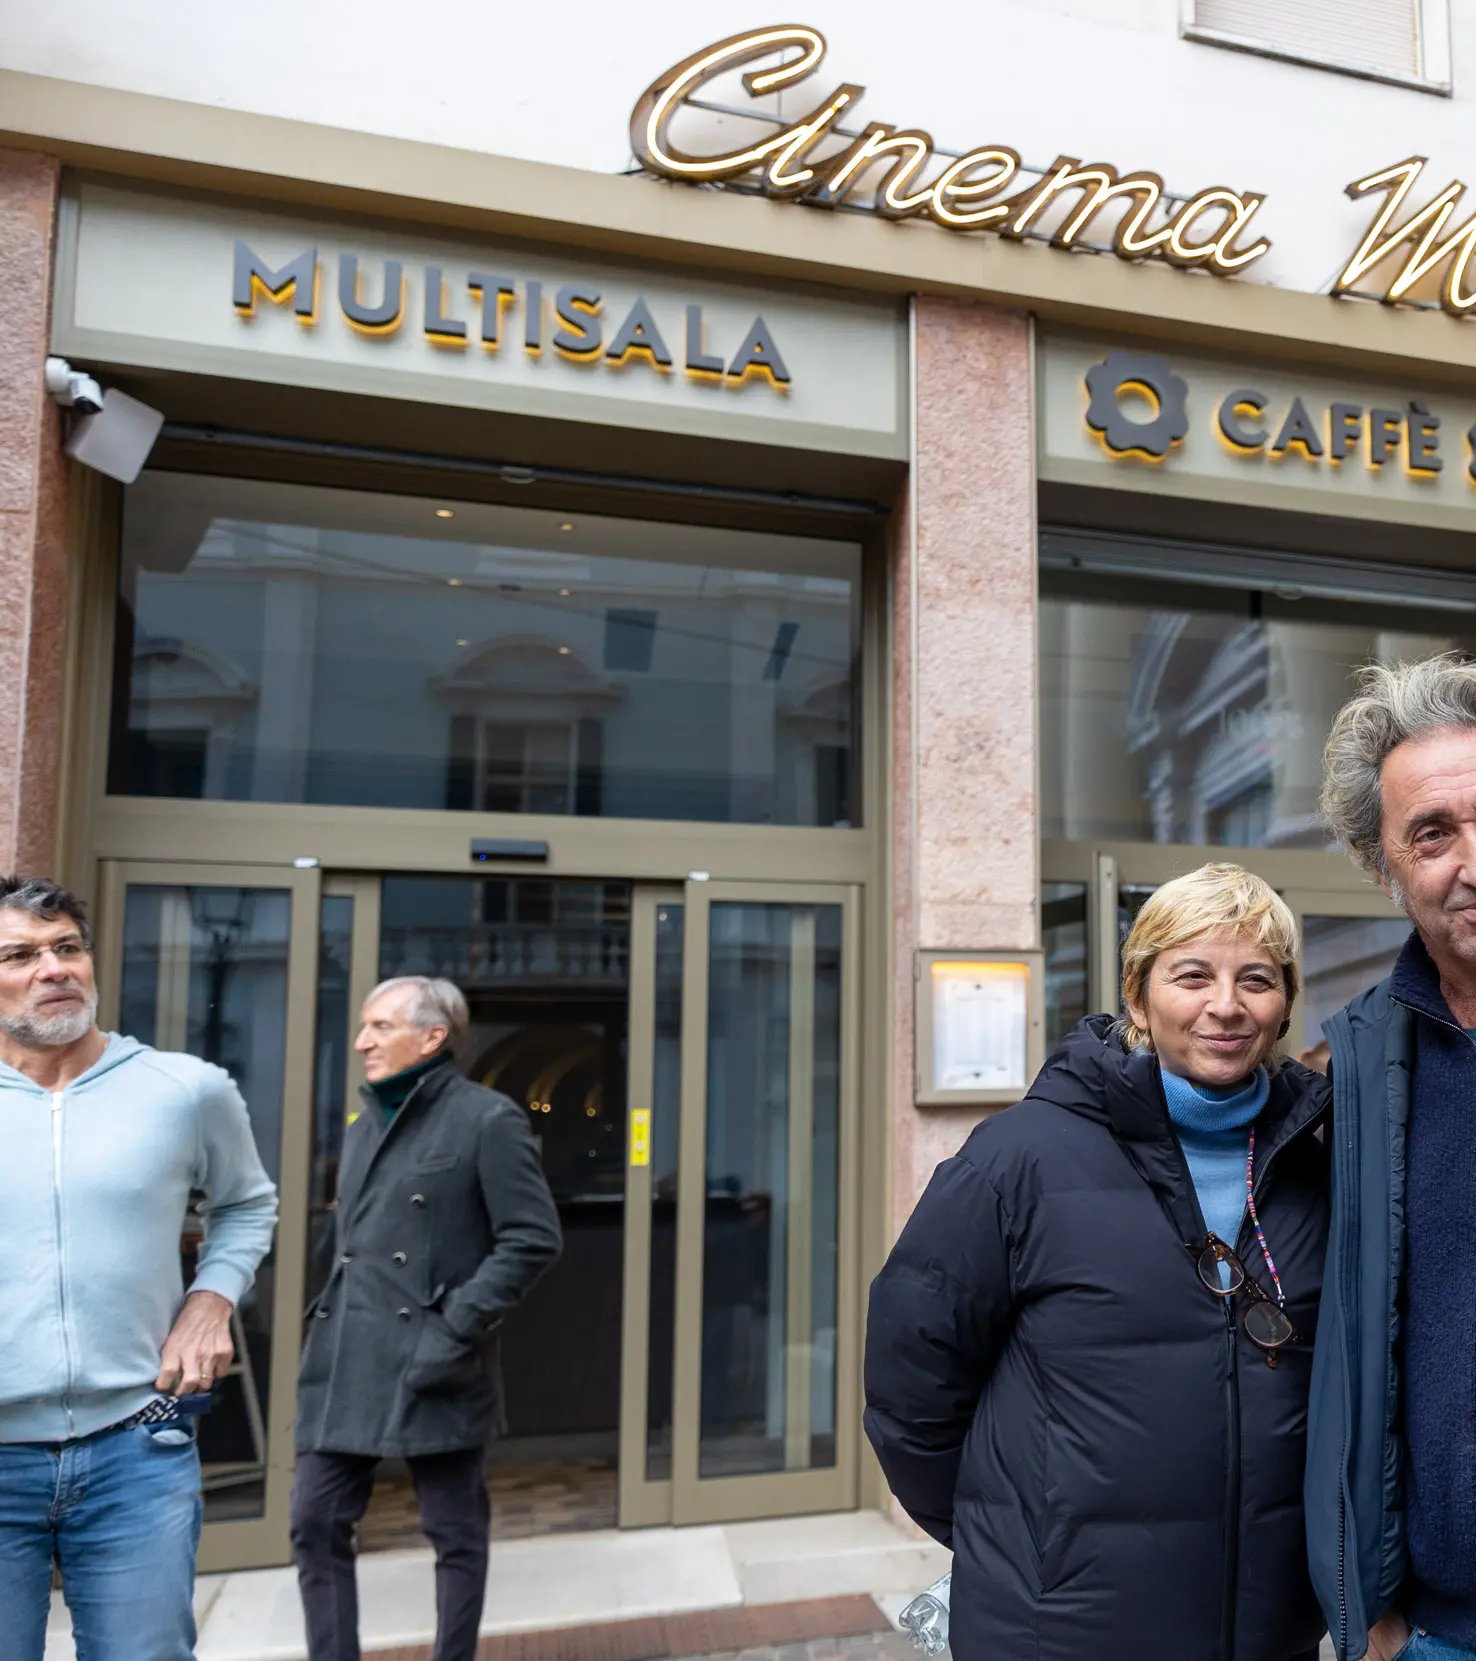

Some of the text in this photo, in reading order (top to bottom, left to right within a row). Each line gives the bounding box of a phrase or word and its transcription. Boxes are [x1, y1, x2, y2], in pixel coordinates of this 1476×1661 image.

[630, 24, 1271, 277] Cinema
[232, 240, 792, 390] MULTISALA
[1216, 389, 1444, 474] CAFFÈ
